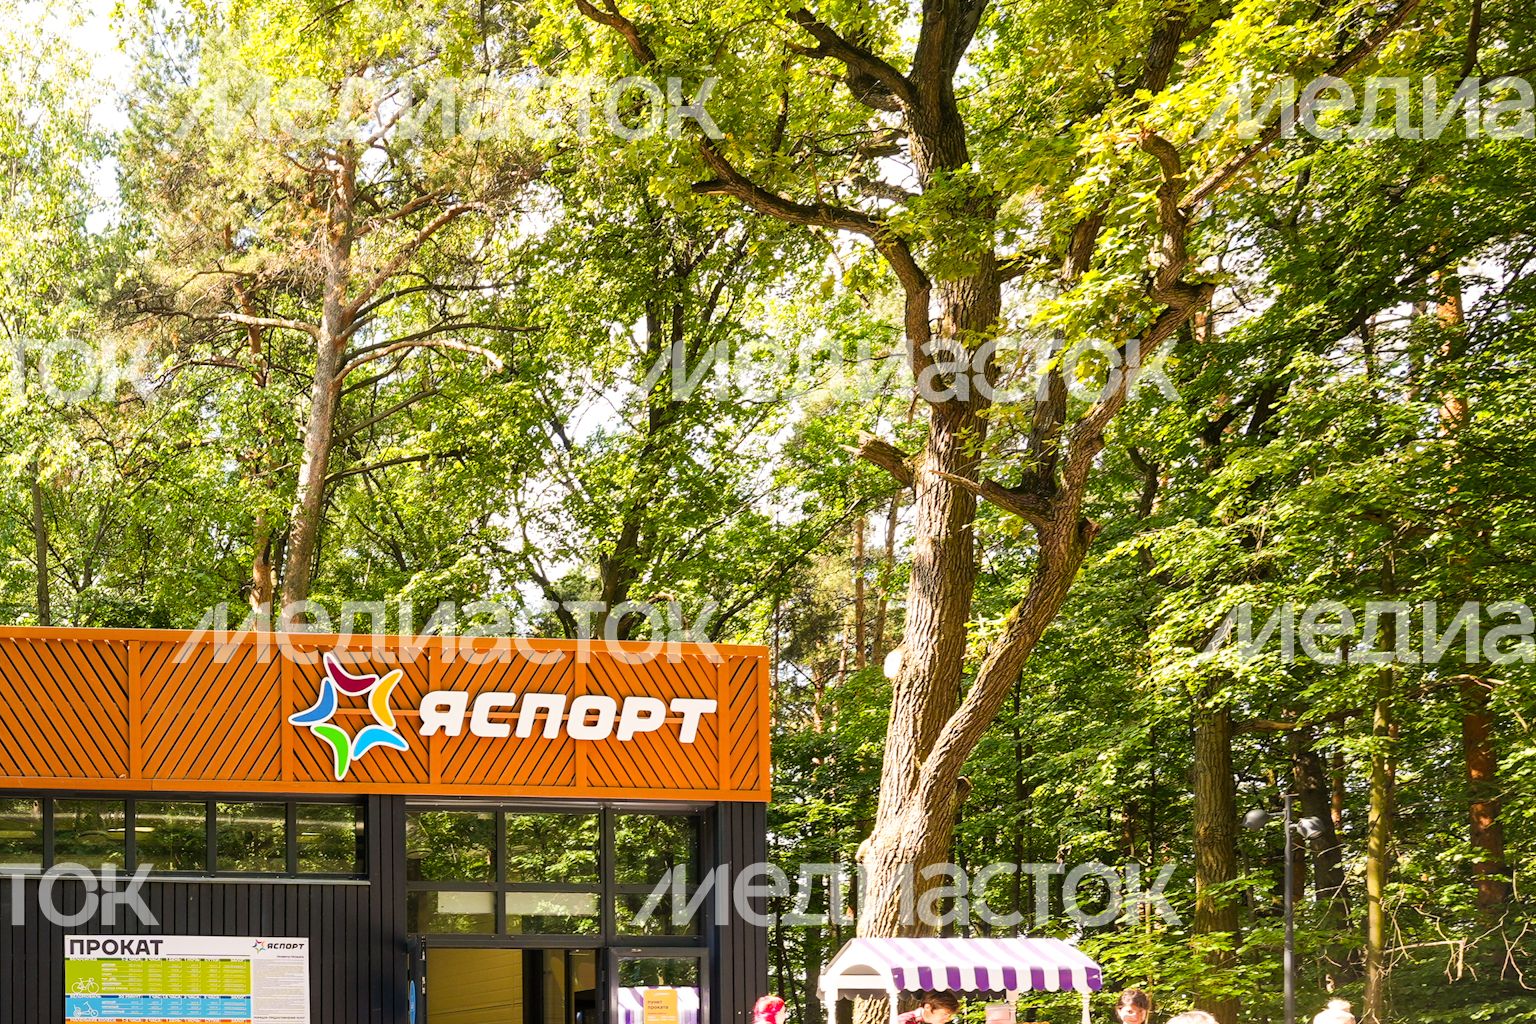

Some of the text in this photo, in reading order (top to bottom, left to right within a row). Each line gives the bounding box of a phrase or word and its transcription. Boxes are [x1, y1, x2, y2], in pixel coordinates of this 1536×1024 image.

[419, 690, 717, 744] ЯСПОРТ
[69, 939, 164, 956] ПРОКАТ
[267, 942, 305, 951] ЯСПОРТ
